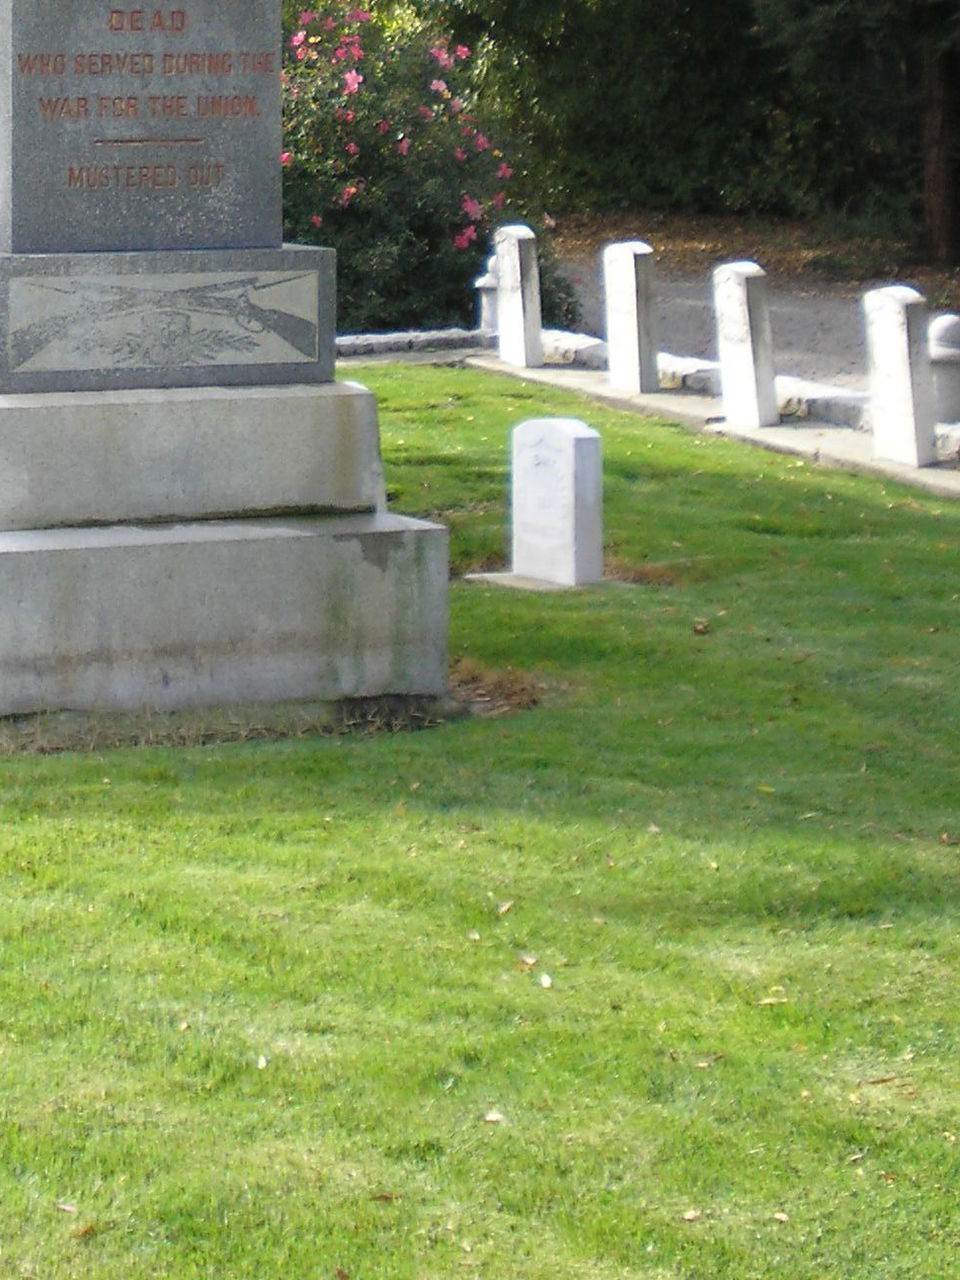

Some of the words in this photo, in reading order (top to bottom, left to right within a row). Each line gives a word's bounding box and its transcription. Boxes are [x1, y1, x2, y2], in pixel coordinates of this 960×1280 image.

[108, 10, 187, 33] DEAD
[17, 53, 66, 77] WHO
[74, 53, 154, 76] SERVED
[163, 53, 233, 75] DURING
[240, 51, 276, 74] THE
[39, 97, 89, 120] WAR
[99, 96, 139, 118] FOR
[148, 96, 188, 117] THE
[68, 166, 177, 189] MUSTERED
[190, 165, 225, 188] OUT
